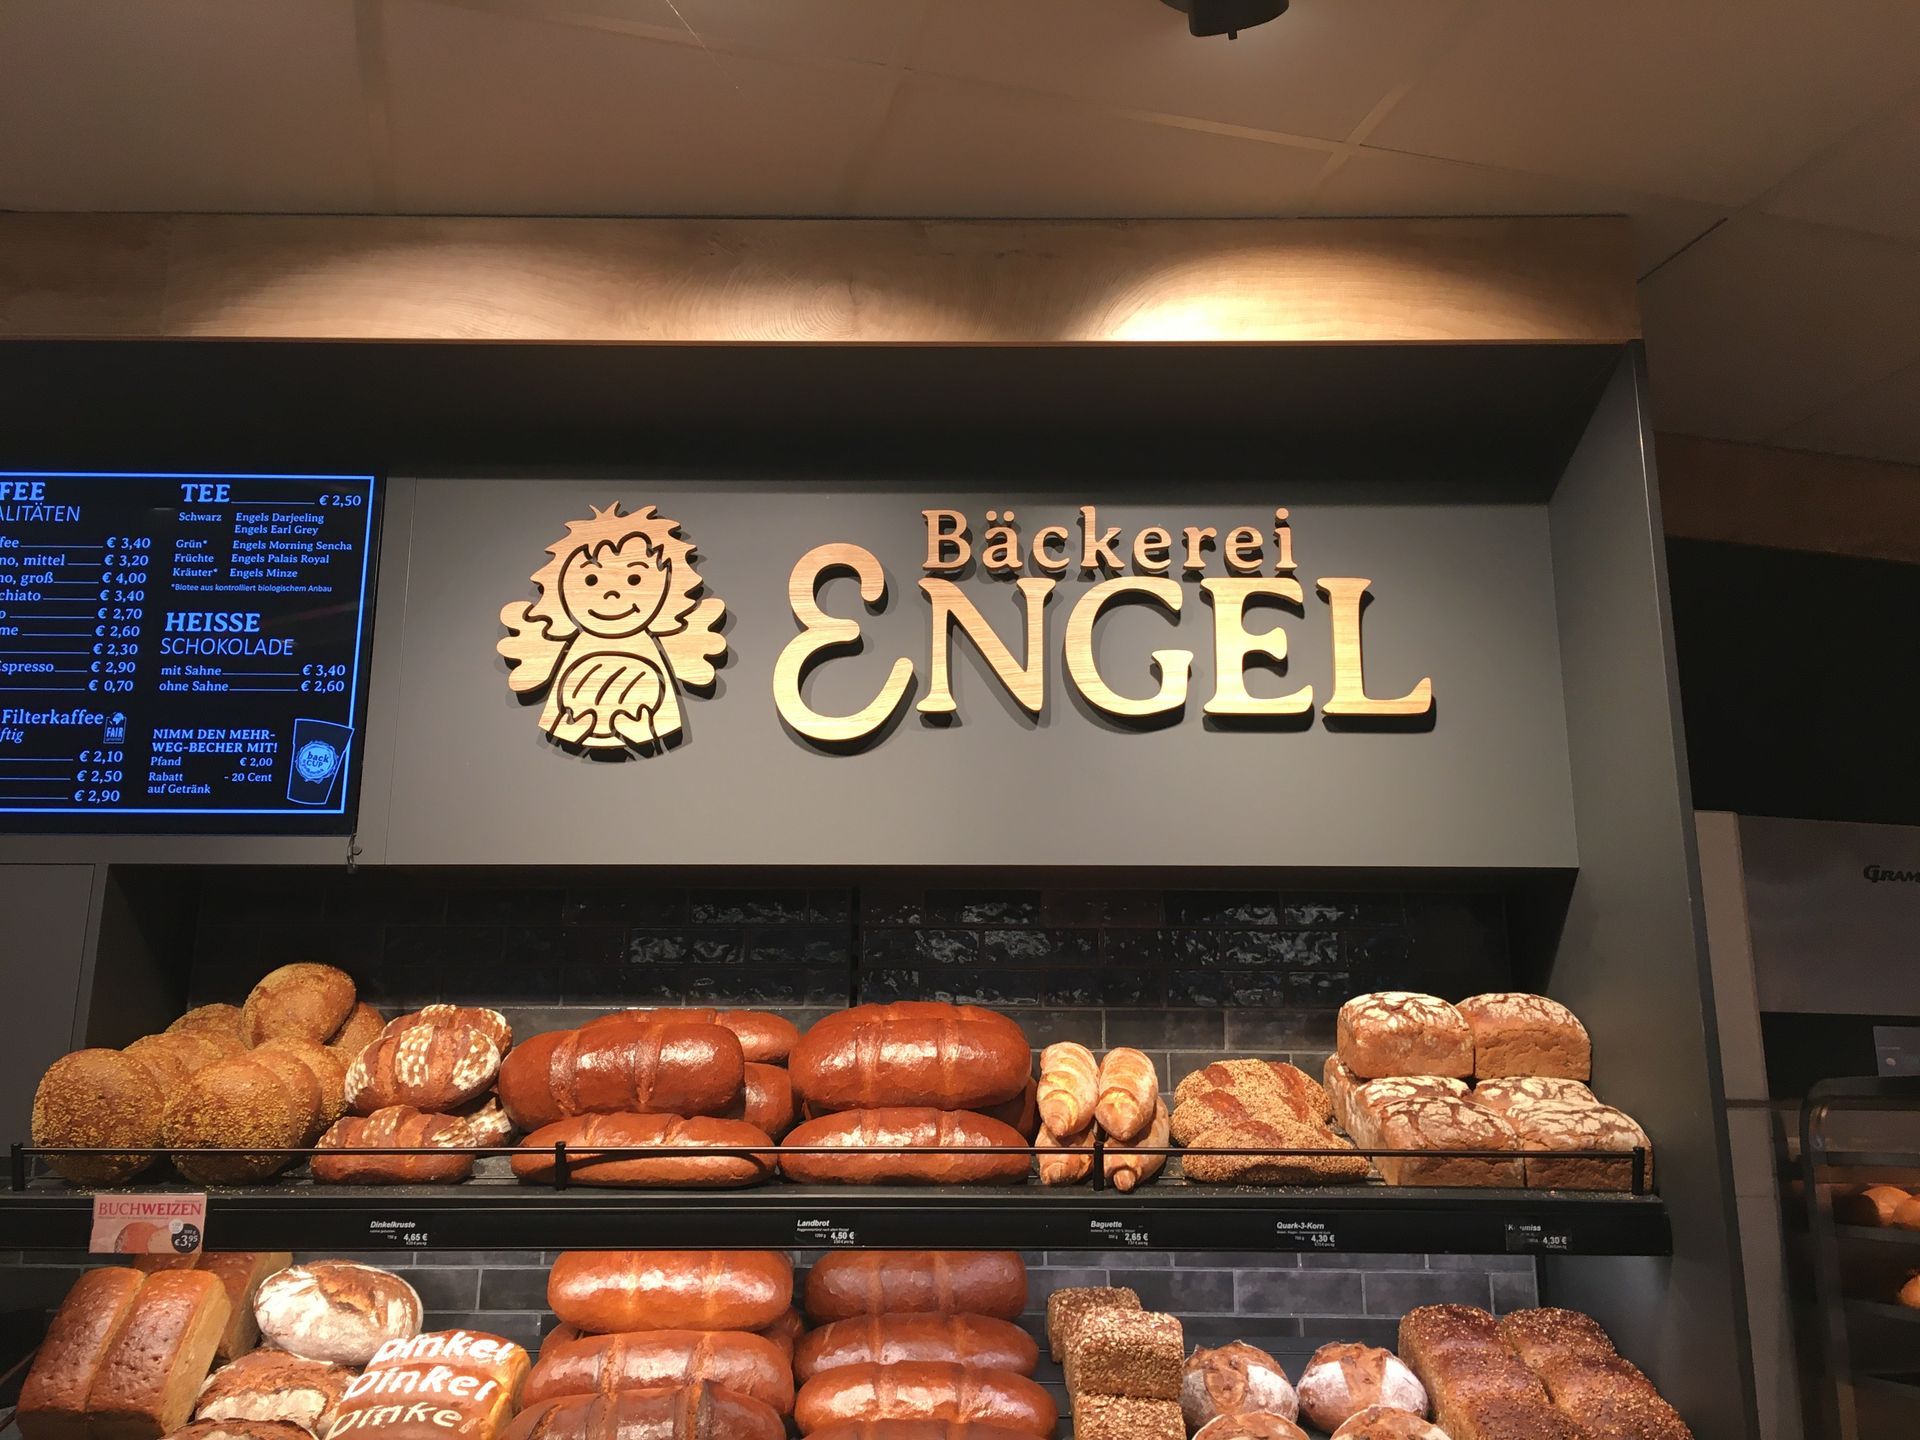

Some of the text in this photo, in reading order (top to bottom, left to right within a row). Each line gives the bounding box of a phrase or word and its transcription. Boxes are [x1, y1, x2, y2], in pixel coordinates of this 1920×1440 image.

[181, 484, 361, 507] TEE € 2,50
[179, 513, 324, 524] Schwarz Engels Darjeeling
[235, 526, 268, 535] Engels
[295, 526, 319, 536] Grey
[107, 537, 116, 548] €
[121, 538, 151, 550] 3,40
[922, 505, 1298, 571] Bäckerei
[233, 541, 266, 550] Engels
[269, 541, 313, 551] Morning
[316, 542, 352, 550] Sencha
[24, 555, 65, 566] mittel
[105, 555, 114, 565] €
[119, 555, 148, 567] 3,20
[175, 554, 329, 566] Früchte Engels Palais Royal
[20, 572, 53, 586] groß
[102, 572, 112, 583] €
[116, 573, 146, 585] 4,00
[230, 569, 263, 579] Engels
[266, 569, 298, 578] Minze
[258, 585, 306, 593] biologischem
[100, 590, 109, 601] €
[114, 591, 144, 603] 3,40
[98, 608, 107, 618] €
[113, 608, 142, 621] 2,70
[165, 612, 260, 632] HEISSE
[95, 626, 105, 636] €
[110, 626, 140, 638] 2,60
[160, 638, 294, 655] SCHOKOLADE
[772, 542, 1433, 742] ENGEL
[93, 644, 138, 656] € 2,30
[0, 660, 136, 675] spresso € 2,90
[161, 665, 345, 677] mit Sahne € 3,40
[88, 680, 133, 693] € 0,70
[159, 681, 344, 693] ohne Sahne € 2,60
[2, 709, 103, 725] Filterkaffee
[107, 727, 123, 737] FAIR
[153, 729, 276, 740] NIMM DEN MEHR-
[152, 742, 278, 753] WEG-BECHER MIT!
[80, 751, 123, 764] € 2,10
[151, 757, 272, 767] Pfand € 2,00
[307, 752, 329, 763] back
[77, 770, 122, 783] € 2,50
[148, 773, 183, 781] Rabatt
[232, 773, 244, 782] 20
[248, 773, 272, 782] Cent
[148, 784, 210, 794] auf Getränk
[75, 790, 120, 803] € 2,90
[99, 1202, 202, 1216] BUCHWEIZEN
[831, 1232, 847, 1240] 4,50
[1125, 1233, 1141, 1241] 2,65
[1311, 1235, 1328, 1243] 4,30
[1543, 1237, 1559, 1245] 4,30
[370, 1331, 514, 1365] Dinkel
[342, 1365, 497, 1402] Dinkel
